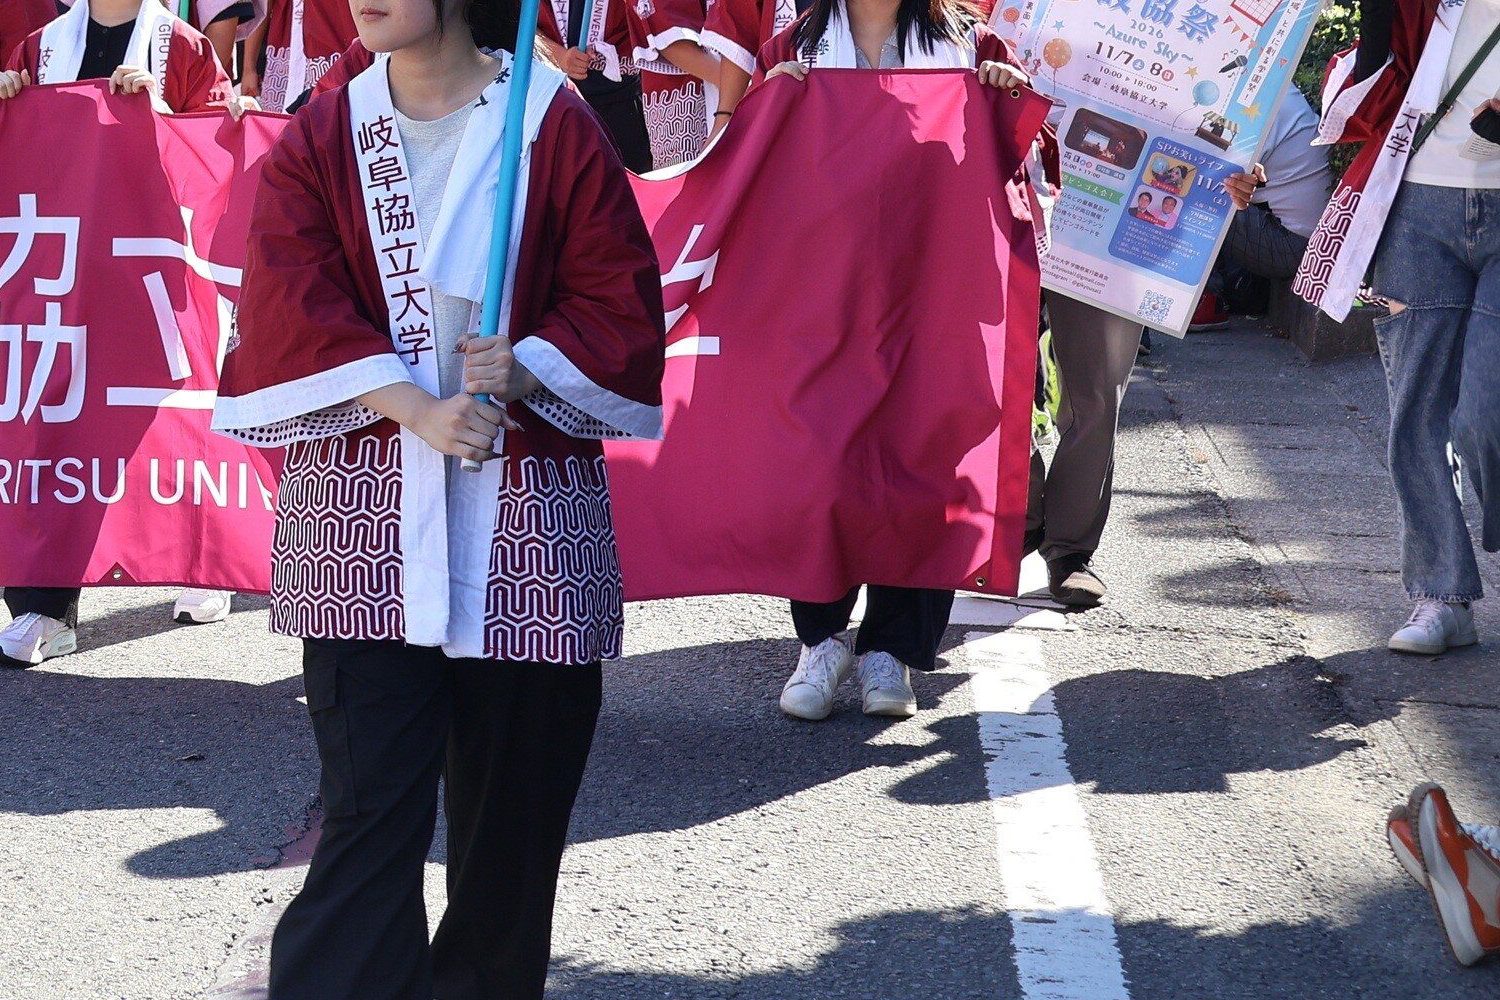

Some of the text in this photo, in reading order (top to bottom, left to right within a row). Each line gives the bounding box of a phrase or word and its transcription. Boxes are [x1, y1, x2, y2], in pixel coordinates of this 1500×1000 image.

[158, 24, 171, 53] GIFU
[1130, 18, 1164, 39] 2026
[1099, 66, 1157, 92] 10:00 18:00
[358, 115, 433, 366] 岐阜協立大学
